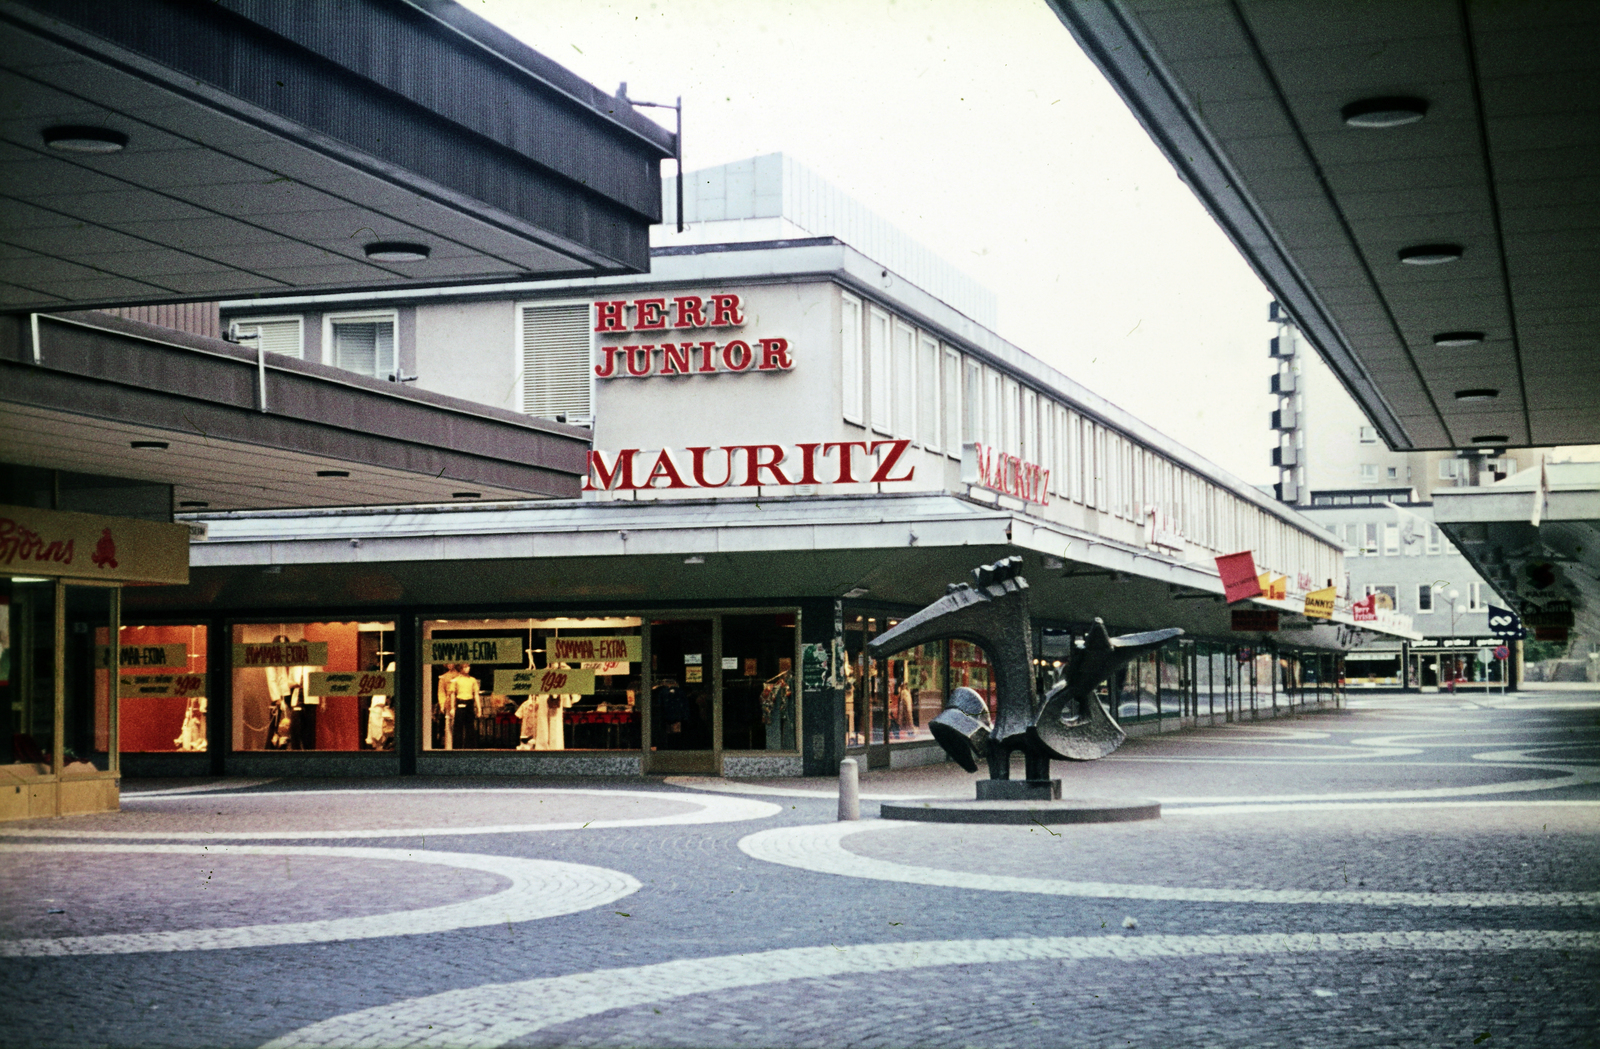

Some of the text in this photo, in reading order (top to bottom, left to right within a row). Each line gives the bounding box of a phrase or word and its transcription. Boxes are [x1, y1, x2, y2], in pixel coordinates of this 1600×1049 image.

[594, 294, 744, 332] HERR
[595, 338, 793, 377] JUNIOR
[582, 439, 916, 491] MAURITZ
[975, 442, 1050, 507] MAURITZ
[245, 645, 309, 664] SOMMAR-EXTRA
[432, 641, 498, 661] SOMMAR-EXTRA
[554, 639, 627, 659] SOMMAR-EXTRA
